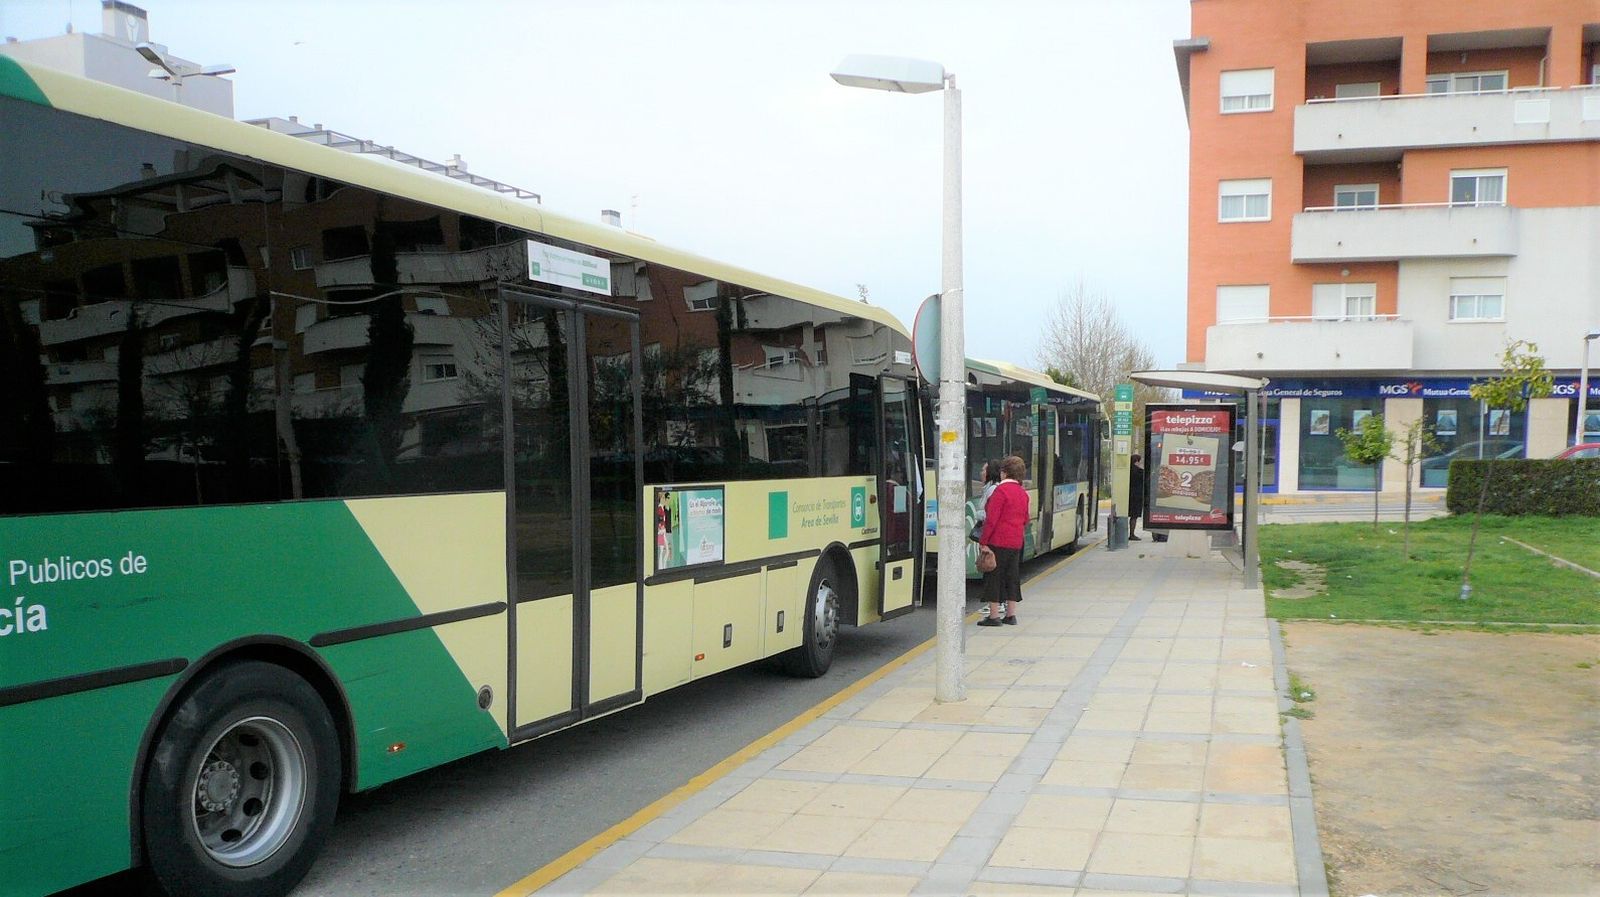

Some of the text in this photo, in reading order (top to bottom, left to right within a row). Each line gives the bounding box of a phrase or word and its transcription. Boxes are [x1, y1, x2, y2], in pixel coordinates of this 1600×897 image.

[1274, 388, 1303, 396] General
[1303, 388, 1313, 396] de
[1314, 388, 1343, 398] Seguros
[1380, 384, 1408, 395] MGS
[1423, 387, 1471, 396] Mutua Gene
[1553, 384, 1576, 395] GS
[1166, 414, 1213, 426] telepizza
[1181, 472, 1193, 487] 2
[1174, 514, 1202, 522] telepizza
[9, 550, 148, 586] Publicos de
